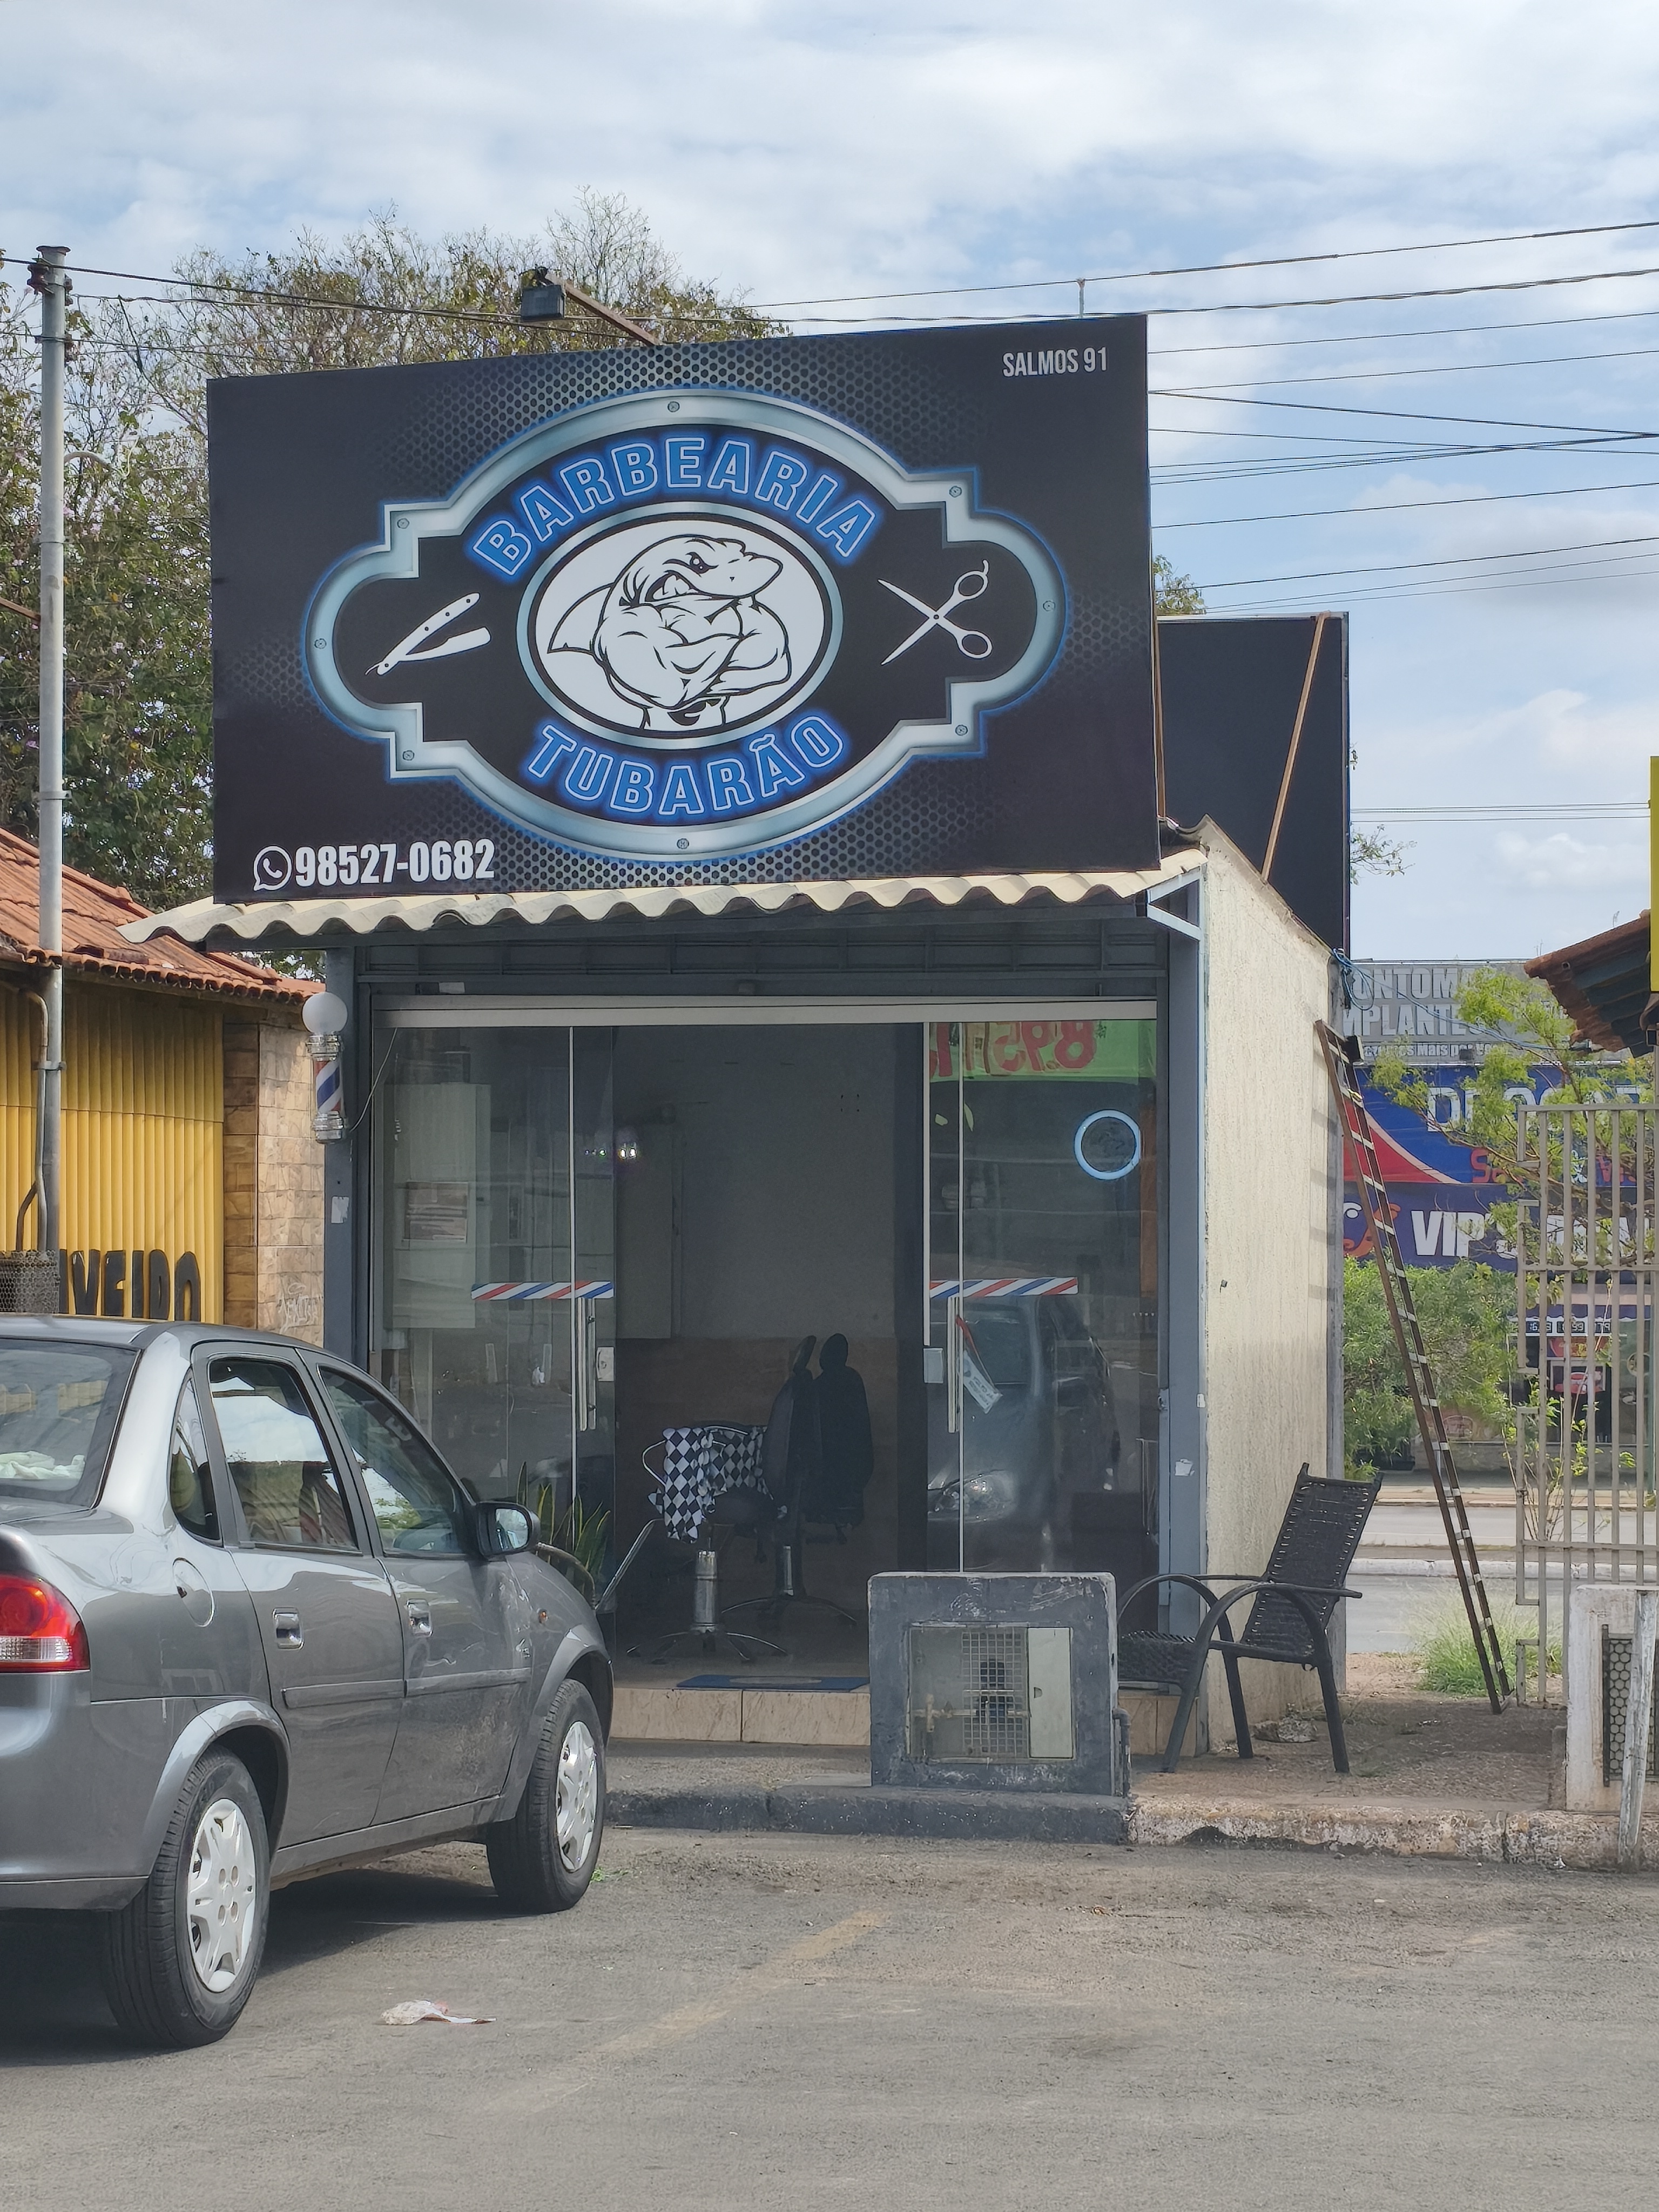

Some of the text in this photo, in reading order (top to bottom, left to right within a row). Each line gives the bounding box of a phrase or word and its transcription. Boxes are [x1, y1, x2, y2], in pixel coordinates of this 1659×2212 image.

[1003, 347, 1107, 377] SALMOS 91
[472, 437, 875, 576] BARBEARIA
[528, 716, 844, 815] TUBARÃO
[295, 839, 495, 887] 98527-0682
[1417, 1042, 1448, 1056] Mais
